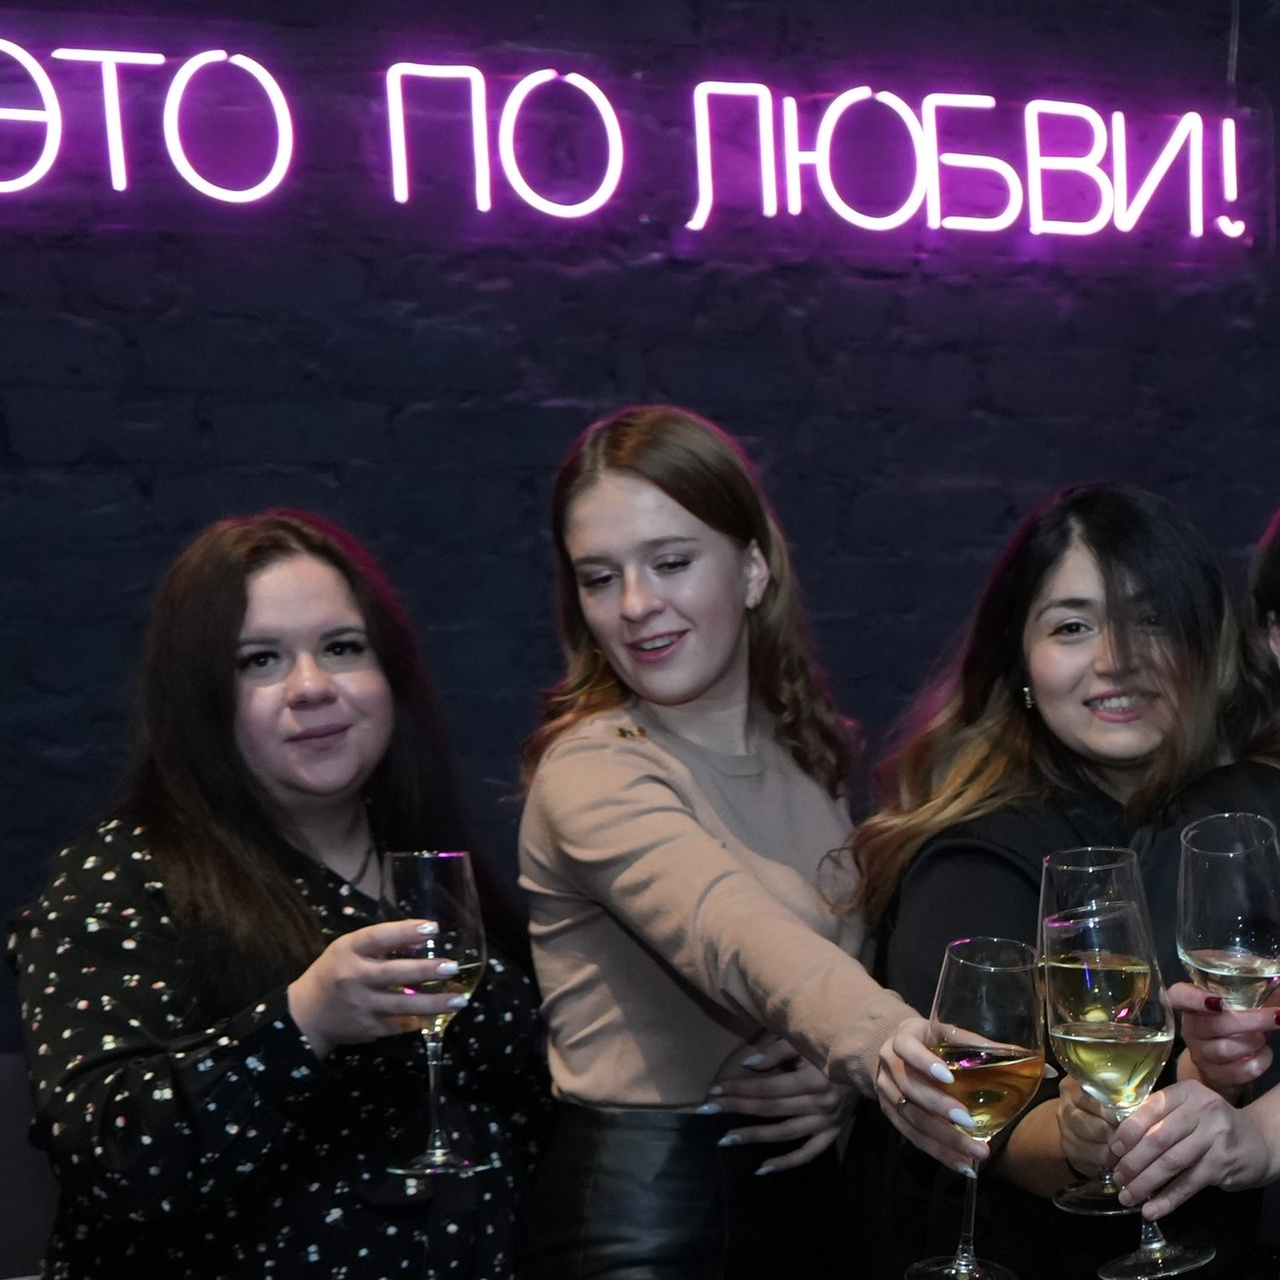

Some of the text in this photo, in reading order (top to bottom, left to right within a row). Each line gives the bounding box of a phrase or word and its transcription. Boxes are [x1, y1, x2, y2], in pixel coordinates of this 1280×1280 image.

[0, 39, 1246, 238] ЭТО ПО ЛЮБВИ!
